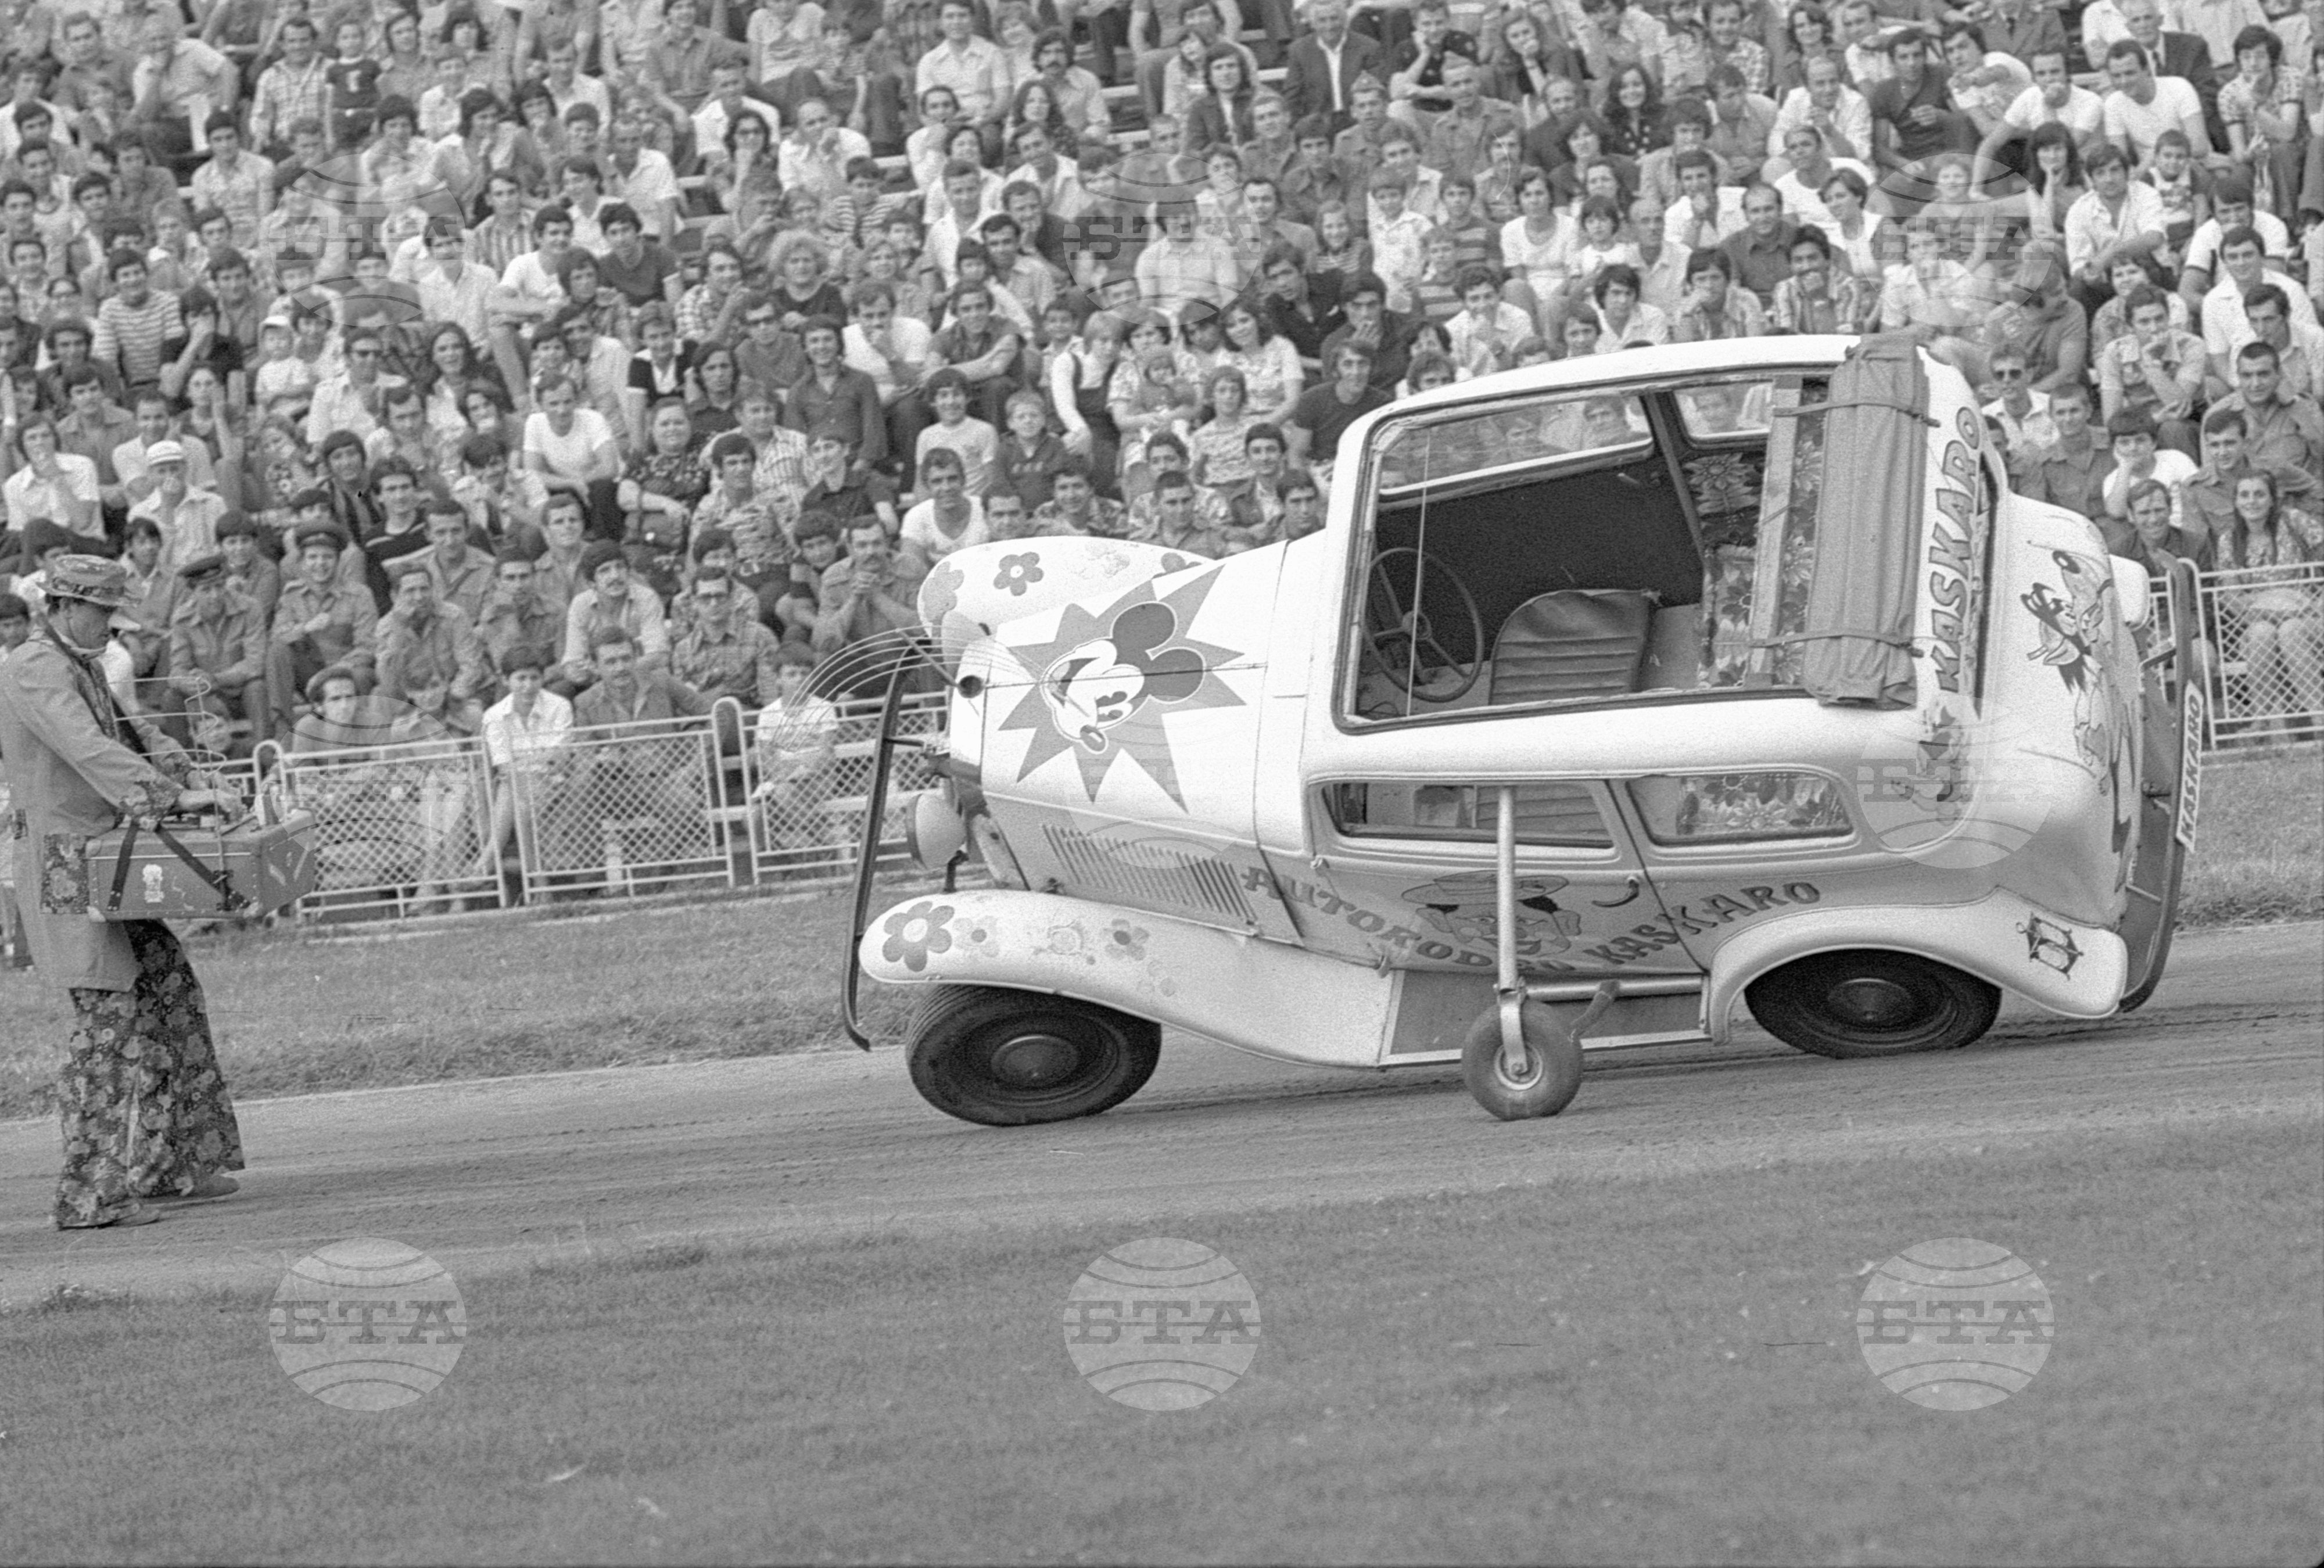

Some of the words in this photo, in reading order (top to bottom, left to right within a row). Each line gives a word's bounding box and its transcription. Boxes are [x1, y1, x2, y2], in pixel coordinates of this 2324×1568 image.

[1930, 407, 1980, 693] KASKARO
[2179, 694, 2201, 841] KASKARO
[1583, 882, 1820, 964] KASKARO
